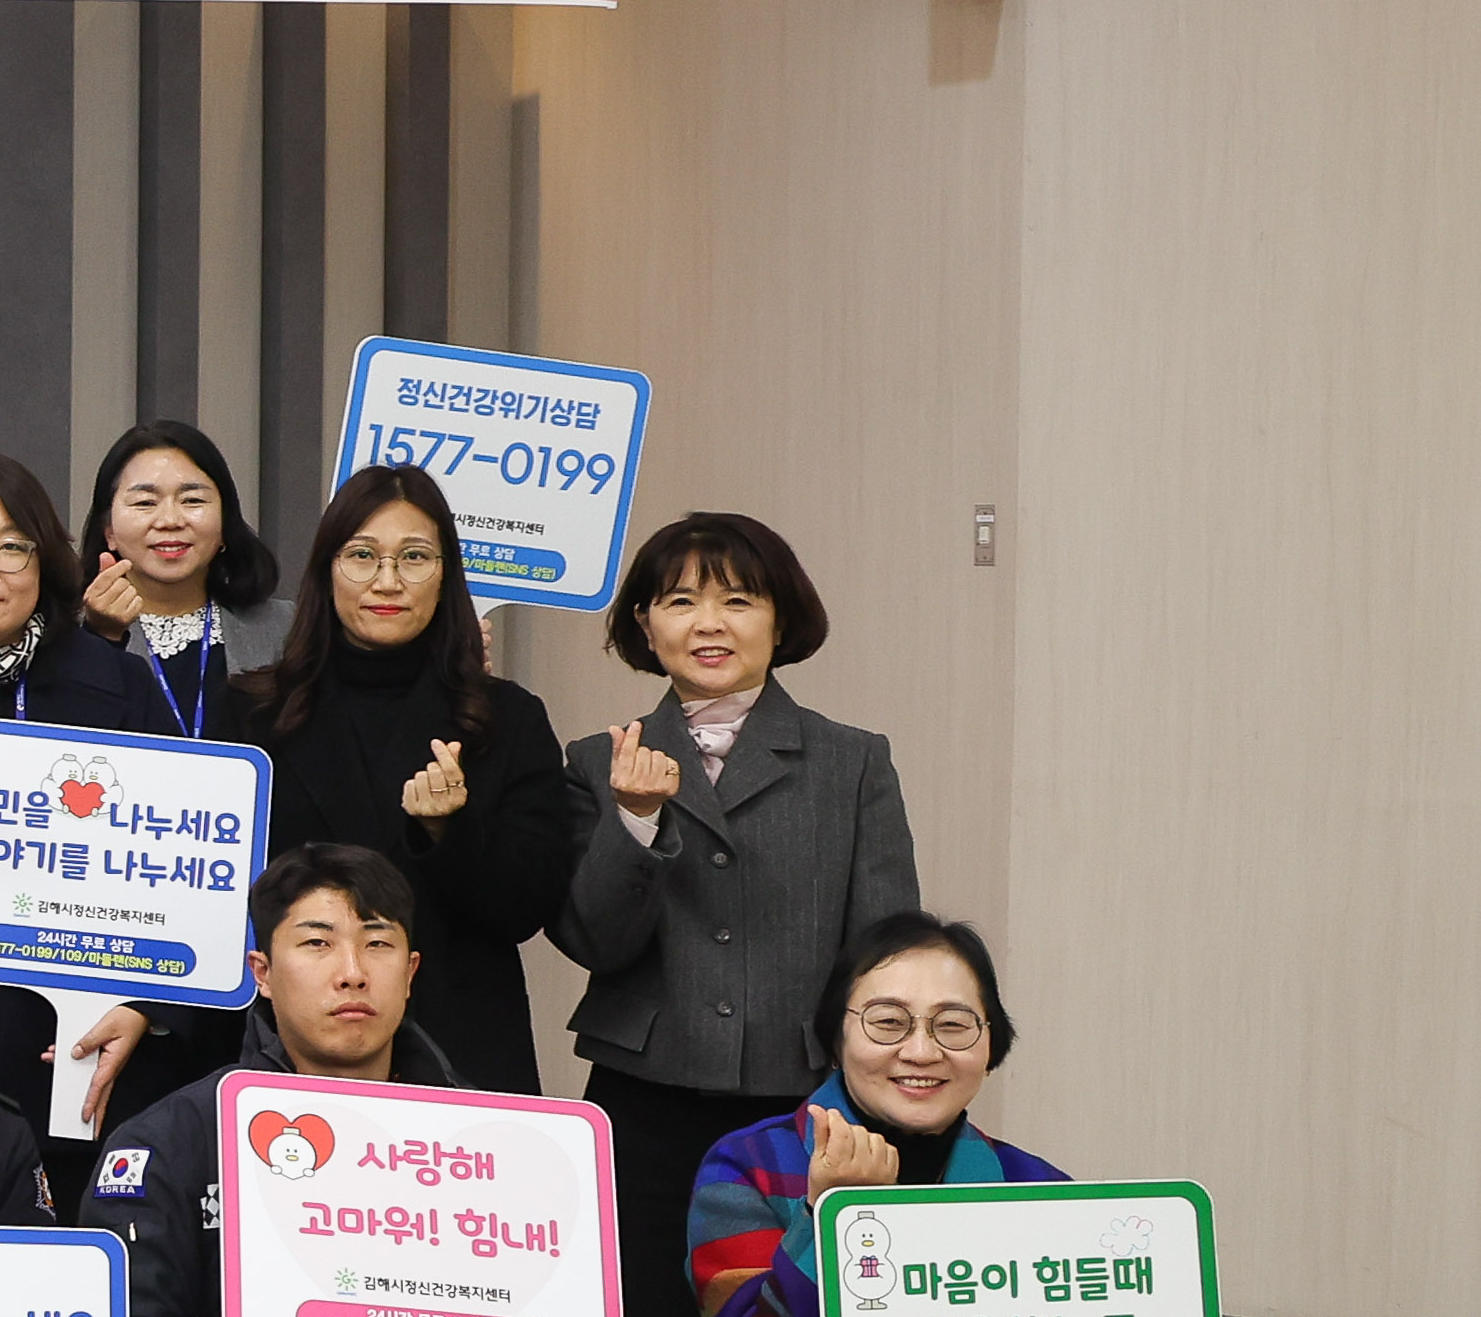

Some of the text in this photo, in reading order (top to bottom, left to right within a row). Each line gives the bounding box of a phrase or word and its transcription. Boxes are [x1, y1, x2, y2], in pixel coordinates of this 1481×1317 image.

[396, 377, 601, 430] 정신건강위기상담
[368, 424, 615, 495] 1577-0199
[109, 802, 242, 845] 나누세요
[104, 849, 236, 892] 나누세요
[38, 900, 166, 926] 김해시정신건강복지센터
[37, 930, 135, 953] 24시간 무료 상담
[156, 957, 185, 974] 상담)
[357, 1139, 496, 1187] 사랑해
[99, 1185, 135, 1194] KOREA
[298, 1201, 561, 1259] 고마워! 힘내!
[363, 1275, 511, 1304] 김해시정신건강복지센터
[902, 1255, 1154, 1306] 마음이 힘들때
